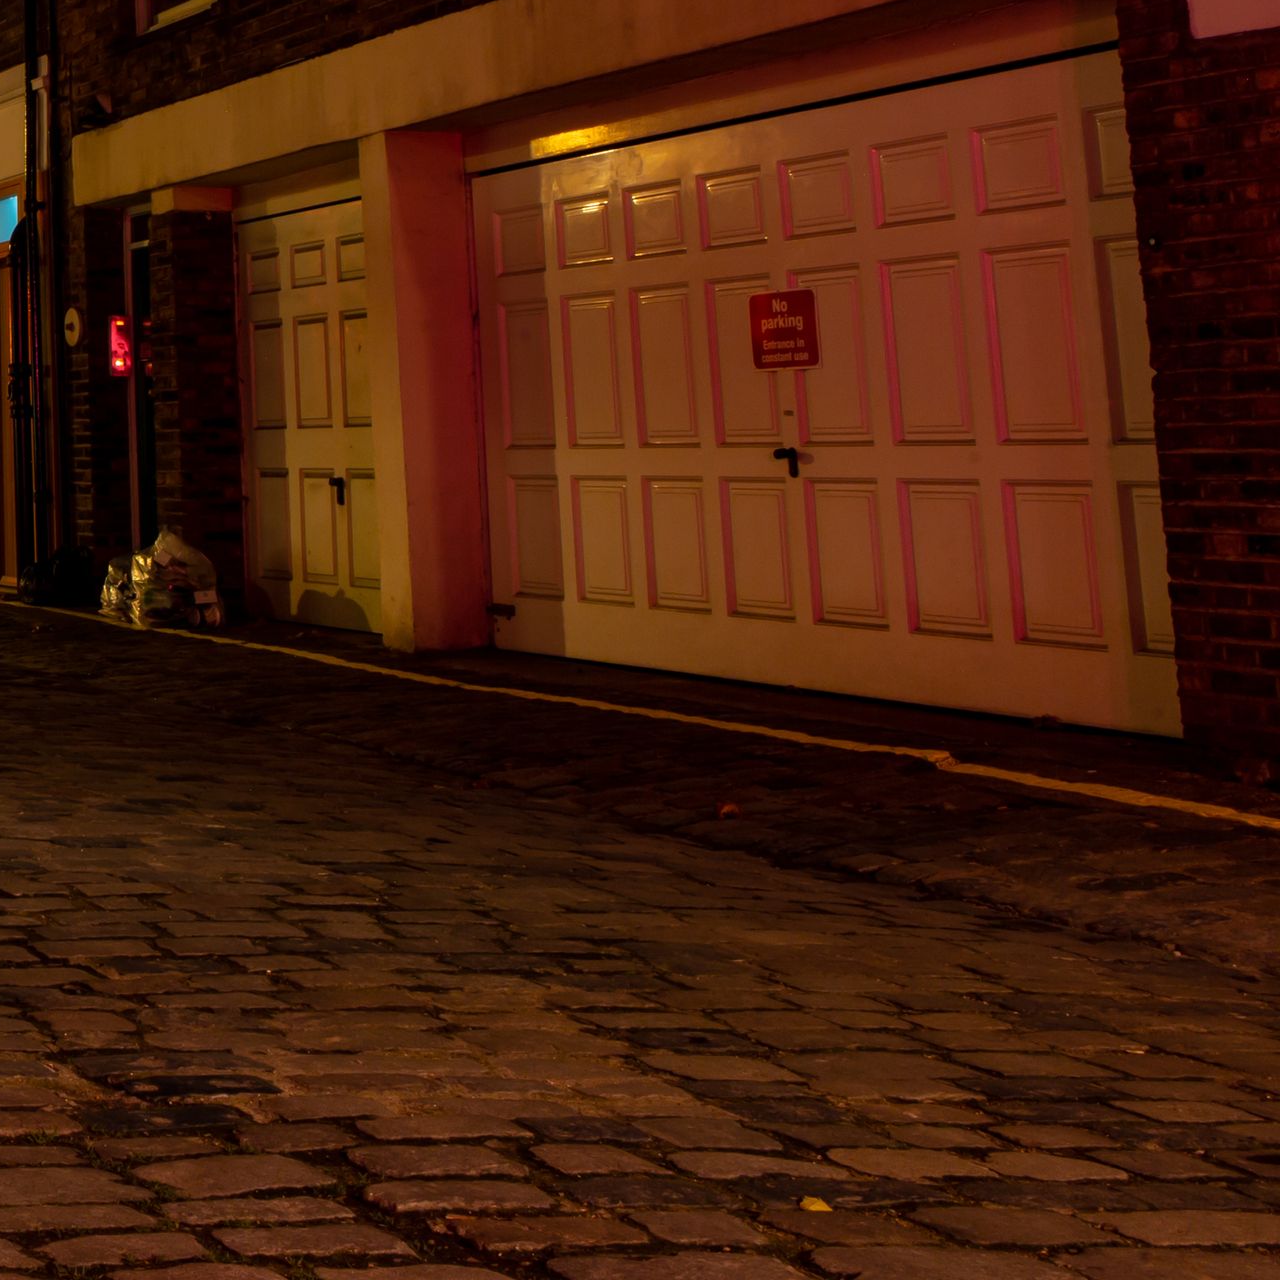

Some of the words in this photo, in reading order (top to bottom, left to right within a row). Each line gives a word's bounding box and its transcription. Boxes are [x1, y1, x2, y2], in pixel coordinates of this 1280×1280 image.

[772, 298, 788, 313] No
[761, 314, 804, 334] parking
[762, 340, 796, 350] Entrance
[797, 337, 806, 348] in
[761, 352, 793, 363] constant
[793, 352, 809, 361] use
